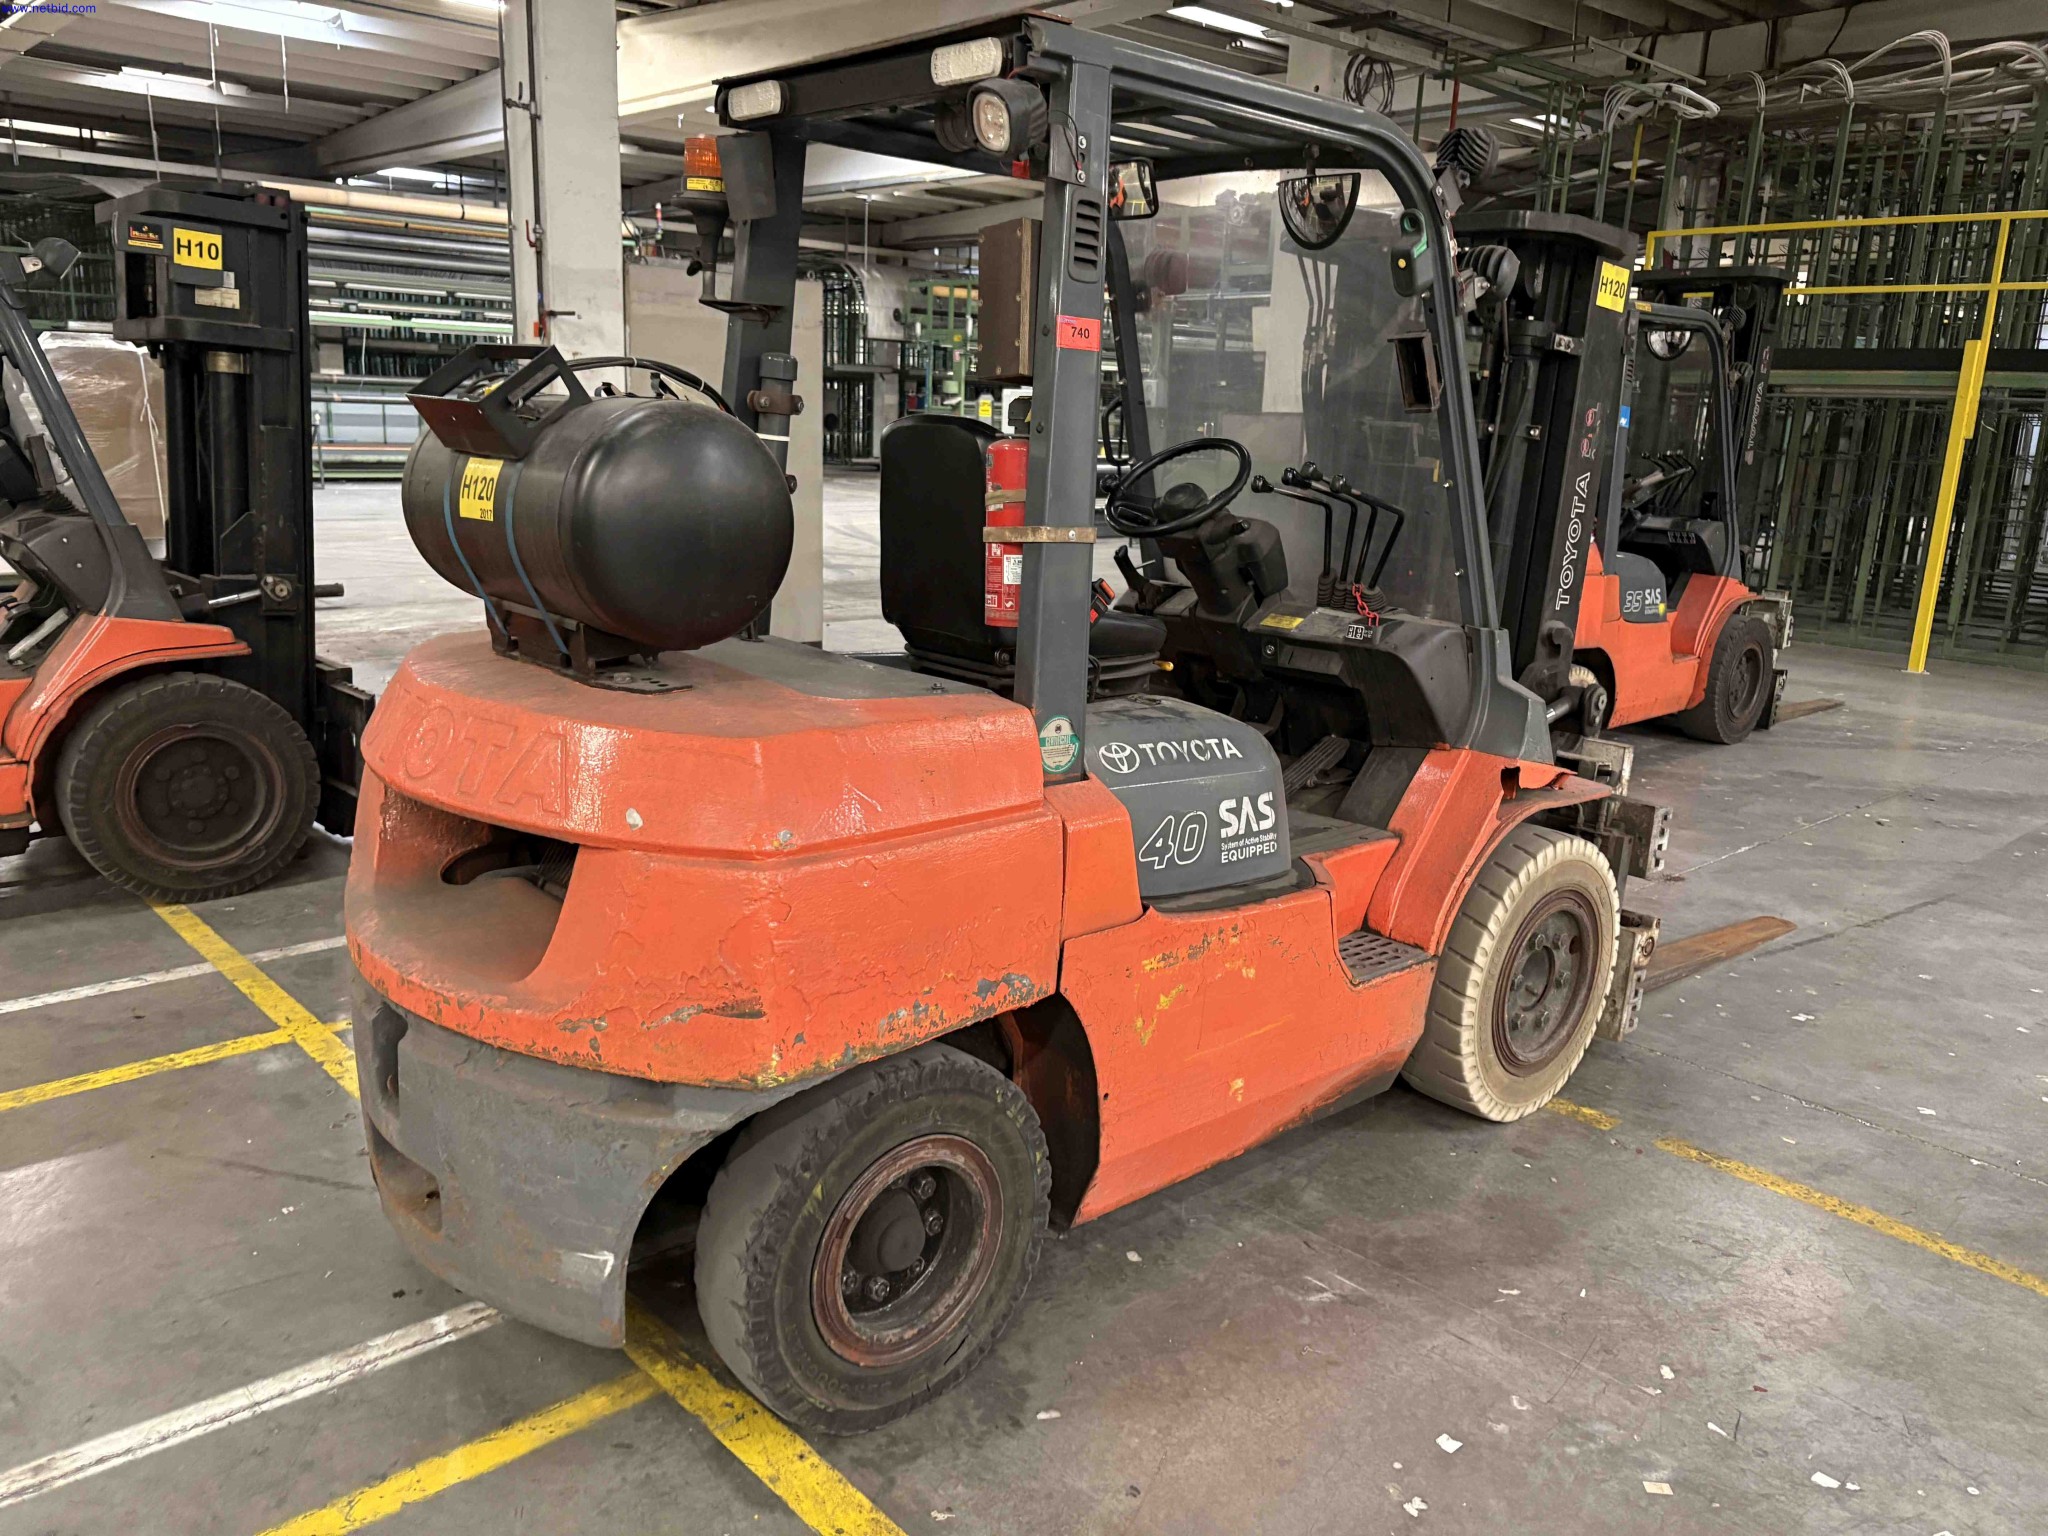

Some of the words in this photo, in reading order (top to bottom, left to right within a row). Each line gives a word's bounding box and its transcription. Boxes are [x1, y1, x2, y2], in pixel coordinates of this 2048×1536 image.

[176, 237, 219, 261] H10
[1600, 275, 1626, 299] H120
[1071, 326, 1090, 340] 740
[461, 474, 495, 502] H120
[480, 508, 493, 520] 2017
[1555, 471, 1591, 611] TOYOTA
[1623, 590, 1644, 613] 35
[1644, 588, 1662, 605] SAS
[1138, 738, 1243, 766] TOYOTA
[1219, 791, 1276, 839] SAS
[1139, 810, 1208, 870] 40
[1221, 841, 1278, 864] EQUIPPED
